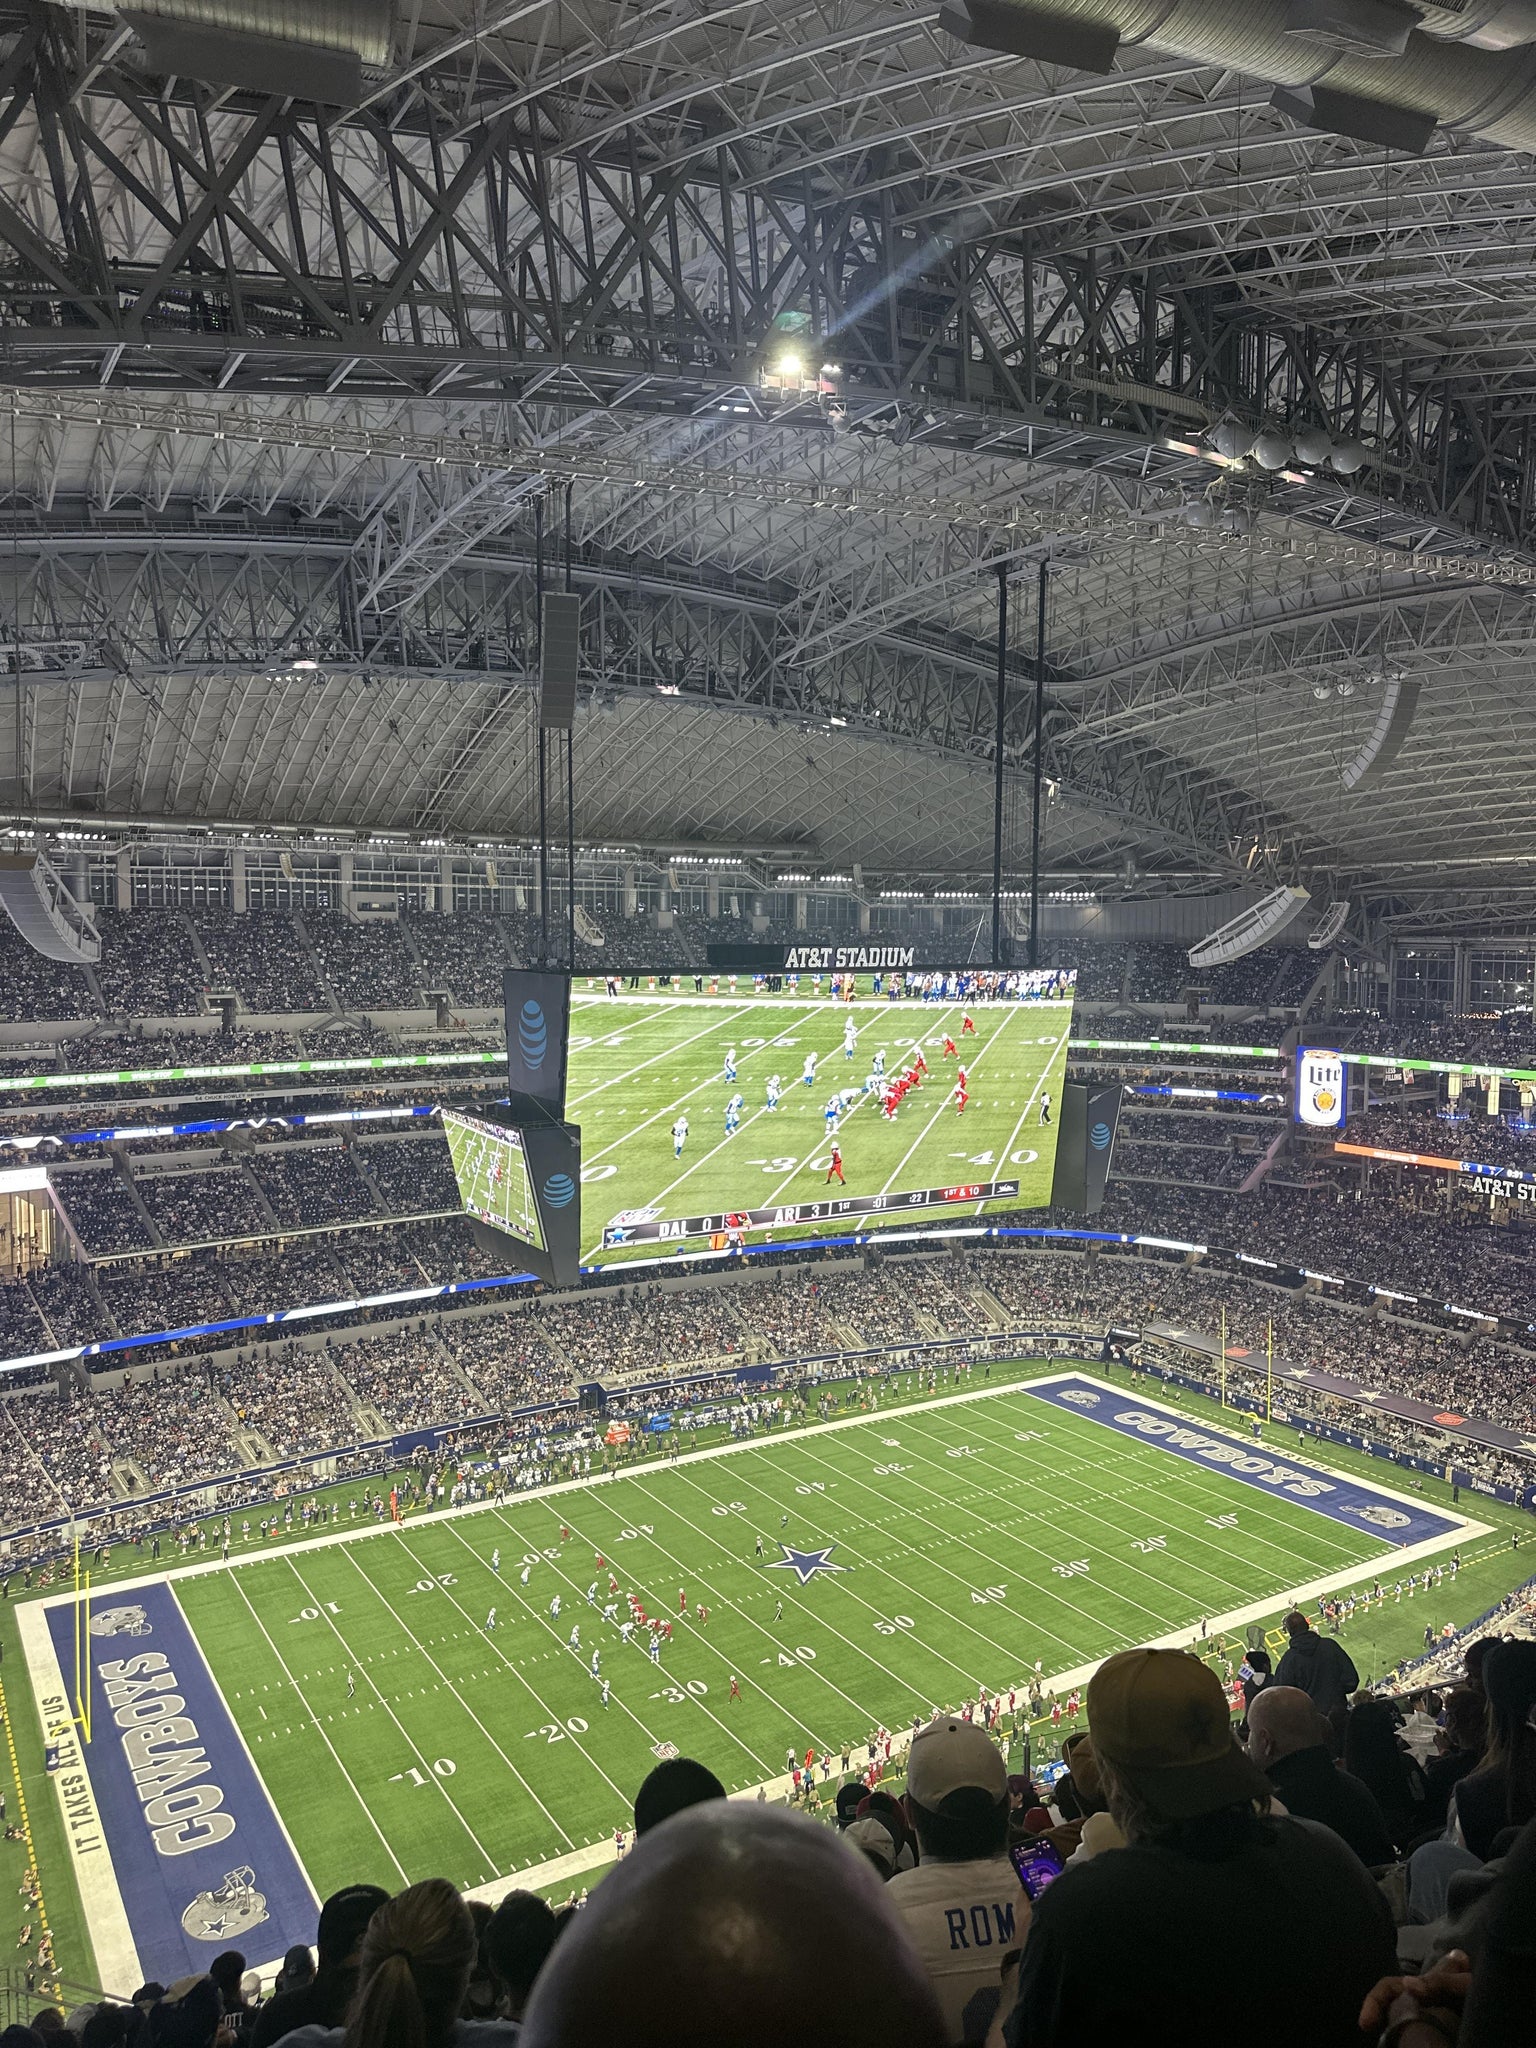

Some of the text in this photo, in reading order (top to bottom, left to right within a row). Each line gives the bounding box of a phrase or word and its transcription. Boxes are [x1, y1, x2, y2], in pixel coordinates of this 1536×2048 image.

[785, 947, 915, 968] AT&T STADIUM
[1309, 1066, 1341, 1086] Lite
[944, 1186, 980, 1199] 1ST & 10
[1472, 1176, 1514, 1198] AT&T
[838, 1197, 887, 1213] 1ST :01
[909, 1193, 923, 1203] :22
[774, 1204, 820, 1223] ARI 3
[659, 1217, 712, 1238] DAL 0
[1240, 1253, 1278, 1269] Blockchain.com
[1304, 1269, 1345, 1285] Blockchain.com
[1374, 1286, 1418, 1304] Blockchain.com
[1451, 1305, 1499, 1322] Blockchain.com
[1175, 1411, 1337, 1473] SALUTE TO SERVICE
[1113, 1411, 1337, 1497] COWBOYS
[1205, 1513, 1235, 1530] 10
[1131, 1536, 1161, 1554] 20
[1051, 1561, 1084, 1579] 30
[970, 1586, 1006, 1606] 40
[873, 1615, 916, 1636] 50
[777, 1646, 817, 1669] 40
[663, 1680, 709, 1705] 30
[41, 1695, 65, 1716] US
[536, 1715, 590, 1744] 20
[58, 1739, 80, 1769] ALL
[98, 1652, 236, 1856] COWBOYS
[404, 1757, 457, 1788] 10
[61, 1774, 95, 1830] TAKES
[75, 1835, 102, 1855] IT
